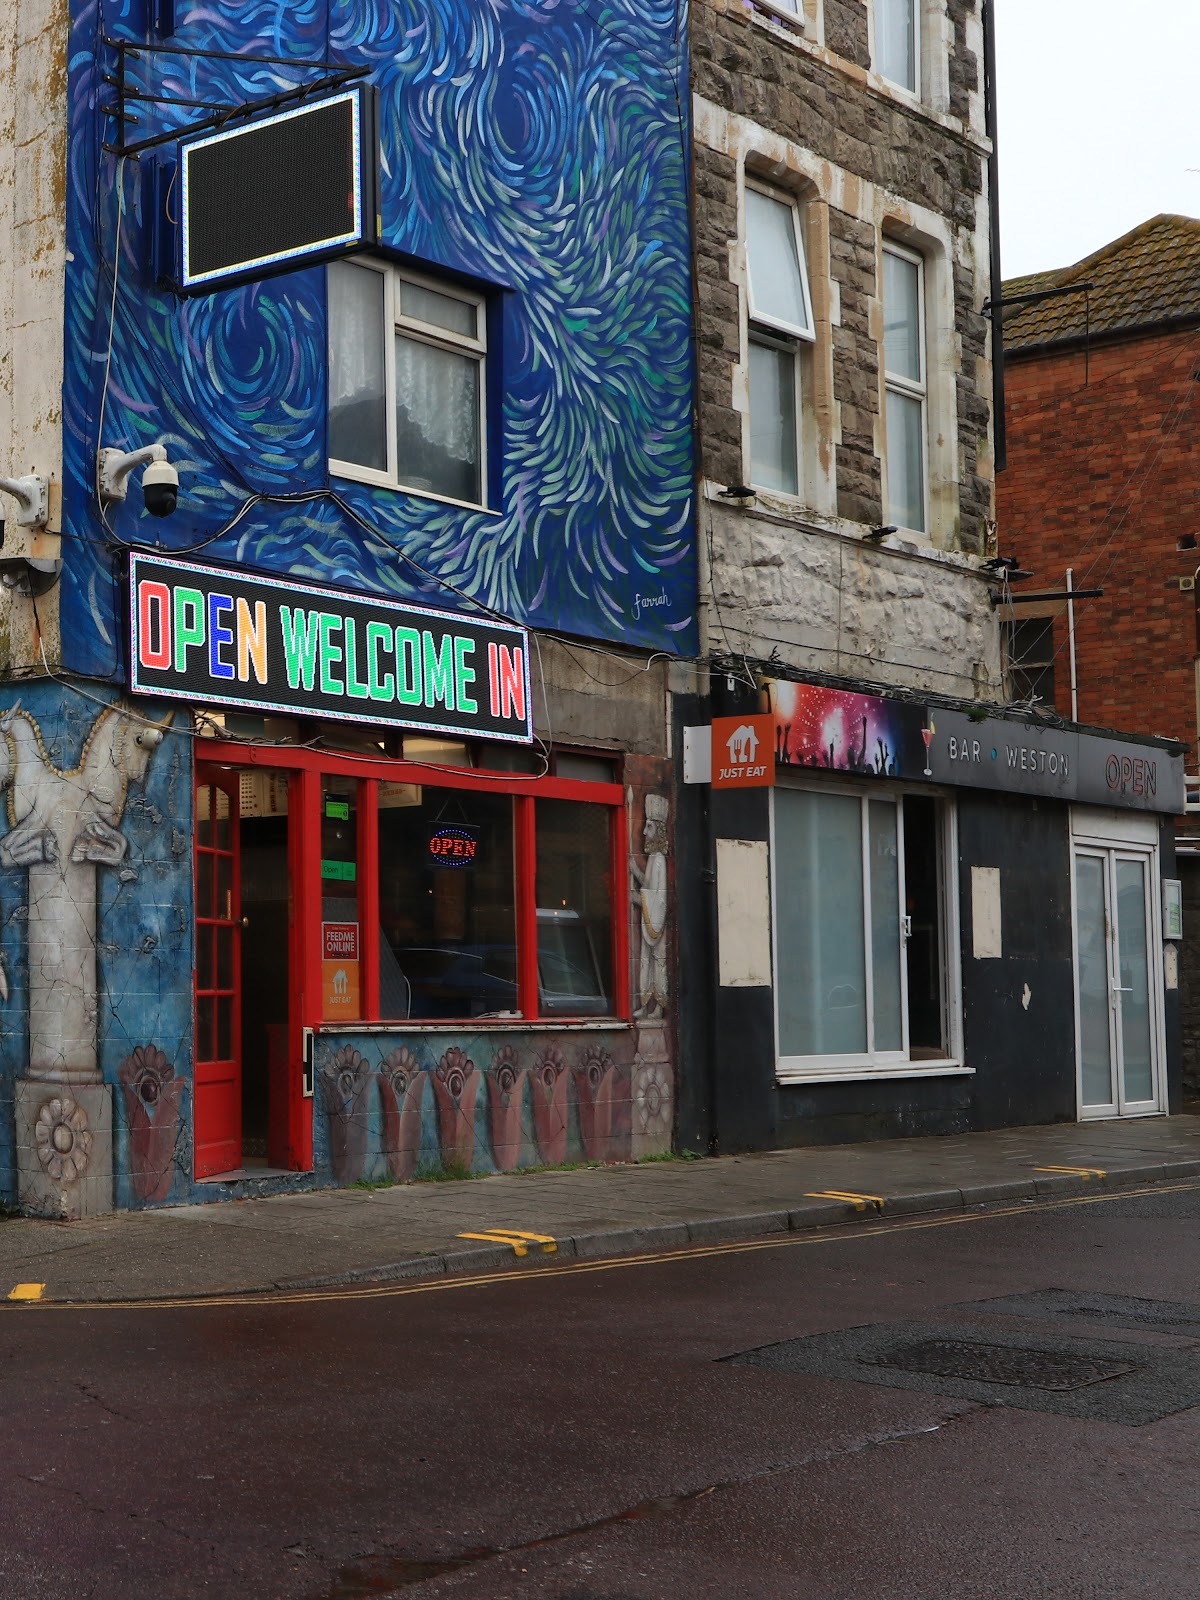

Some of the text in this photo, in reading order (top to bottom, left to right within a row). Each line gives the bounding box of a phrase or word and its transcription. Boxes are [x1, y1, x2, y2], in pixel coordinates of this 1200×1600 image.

[138, 579, 527, 721] OPEN WELCOME IN
[949, 736, 1069, 775] BAR WESTON
[719, 766, 767, 780] JUST EAT
[1105, 754, 1157, 795] OPEN
[430, 838, 477, 857] OPEN
[323, 865, 339, 874] Open
[326, 931, 355, 942] FEEDME
[326, 942, 355, 952] ONLINE
